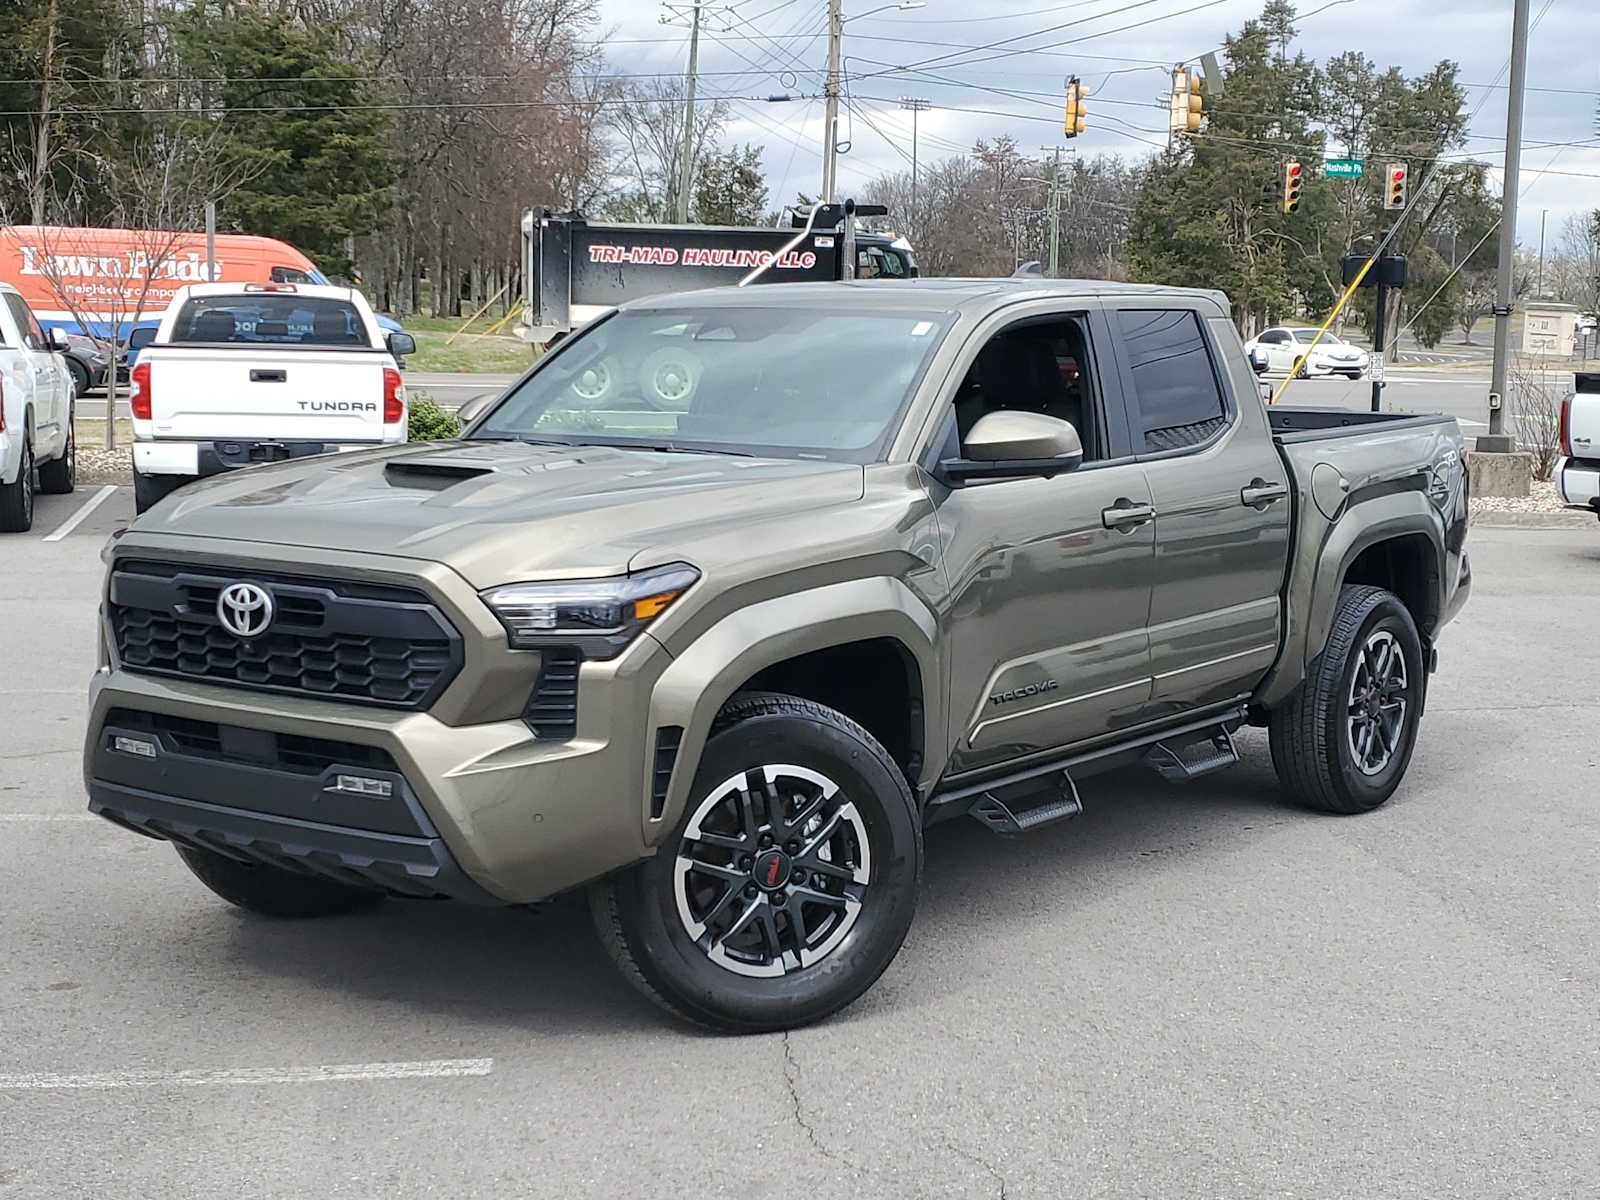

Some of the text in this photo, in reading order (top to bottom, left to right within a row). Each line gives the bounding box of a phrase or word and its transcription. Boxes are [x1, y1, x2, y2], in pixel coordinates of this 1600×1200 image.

[19, 246, 224, 282] Lawn Pride
[589, 245, 817, 269] TRI-MAD HAULING LLC
[297, 401, 377, 412] TUNDRA
[990, 679, 1059, 705] TACOMA
